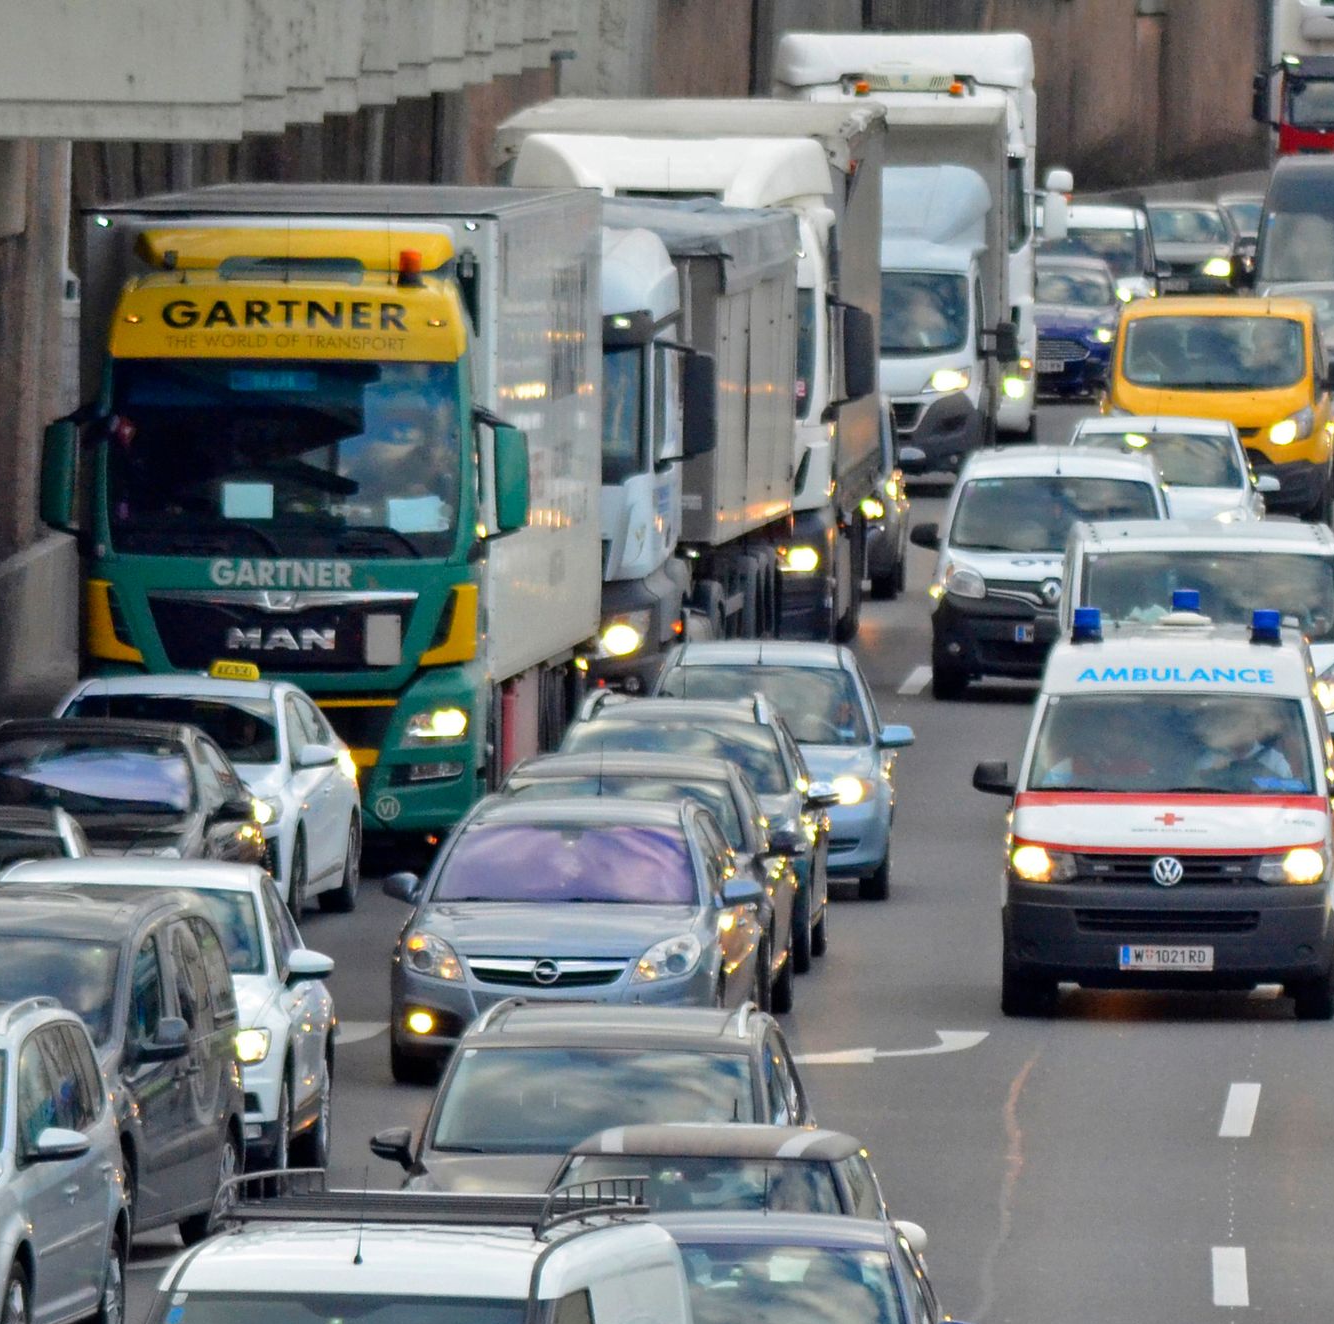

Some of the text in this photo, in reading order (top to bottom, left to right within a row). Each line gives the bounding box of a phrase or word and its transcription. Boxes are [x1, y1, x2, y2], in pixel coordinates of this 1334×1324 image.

[162, 300, 409, 332] GARTNER
[166, 334, 408, 351] THE WORLD OF TRANSPORT
[210, 559, 353, 588] GARTNER
[226, 627, 336, 650] MAN
[217, 665, 252, 676] TAXI
[1076, 667, 1275, 684] AMBULANCE
[1134, 948, 1144, 963] W
